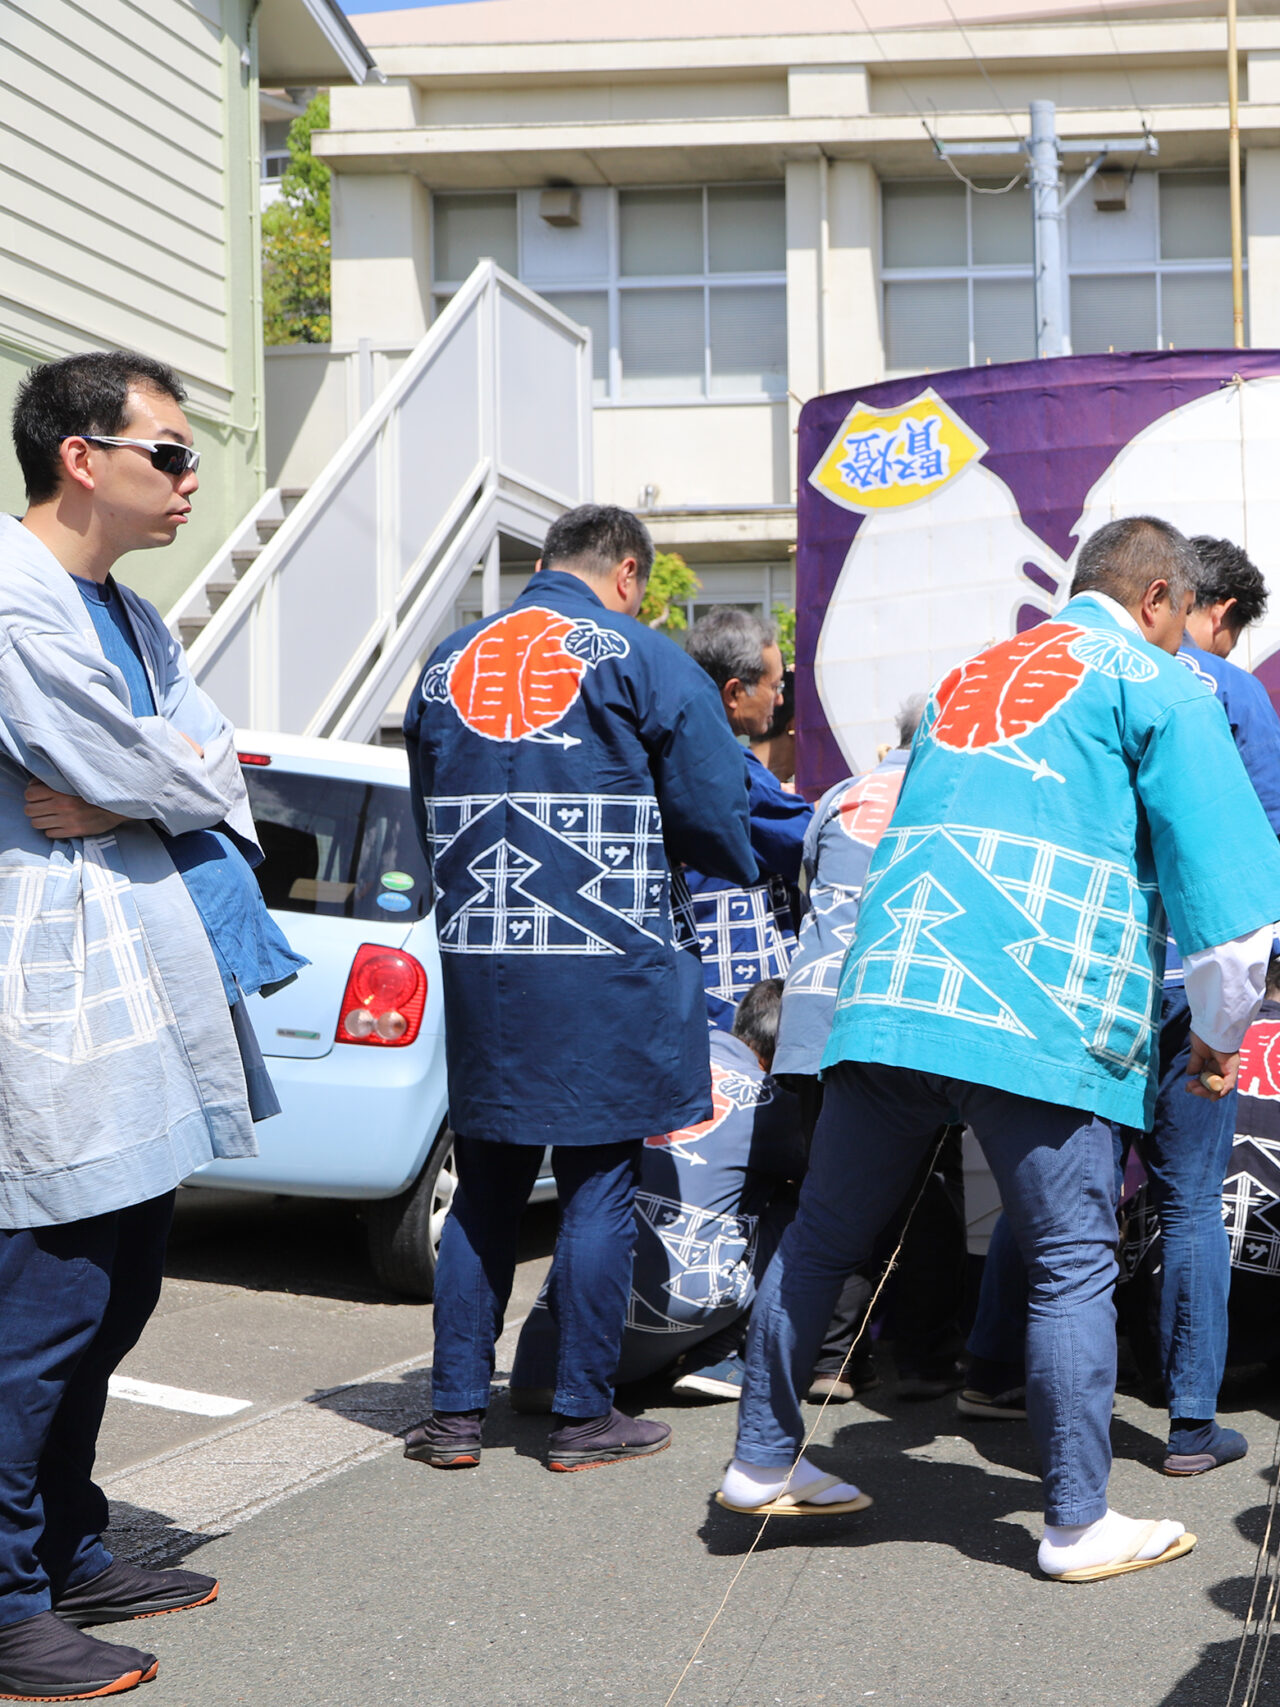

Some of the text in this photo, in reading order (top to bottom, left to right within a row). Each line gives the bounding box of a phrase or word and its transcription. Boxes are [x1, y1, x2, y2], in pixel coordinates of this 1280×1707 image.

[841, 418, 944, 488] 賢燈
[557, 808, 584, 829] サ
[604, 846, 631, 867] サ
[731, 901, 748, 916] ワ
[509, 920, 532, 941] サ
[735, 965, 757, 980] サ
[1246, 1242, 1268, 1260] サ
